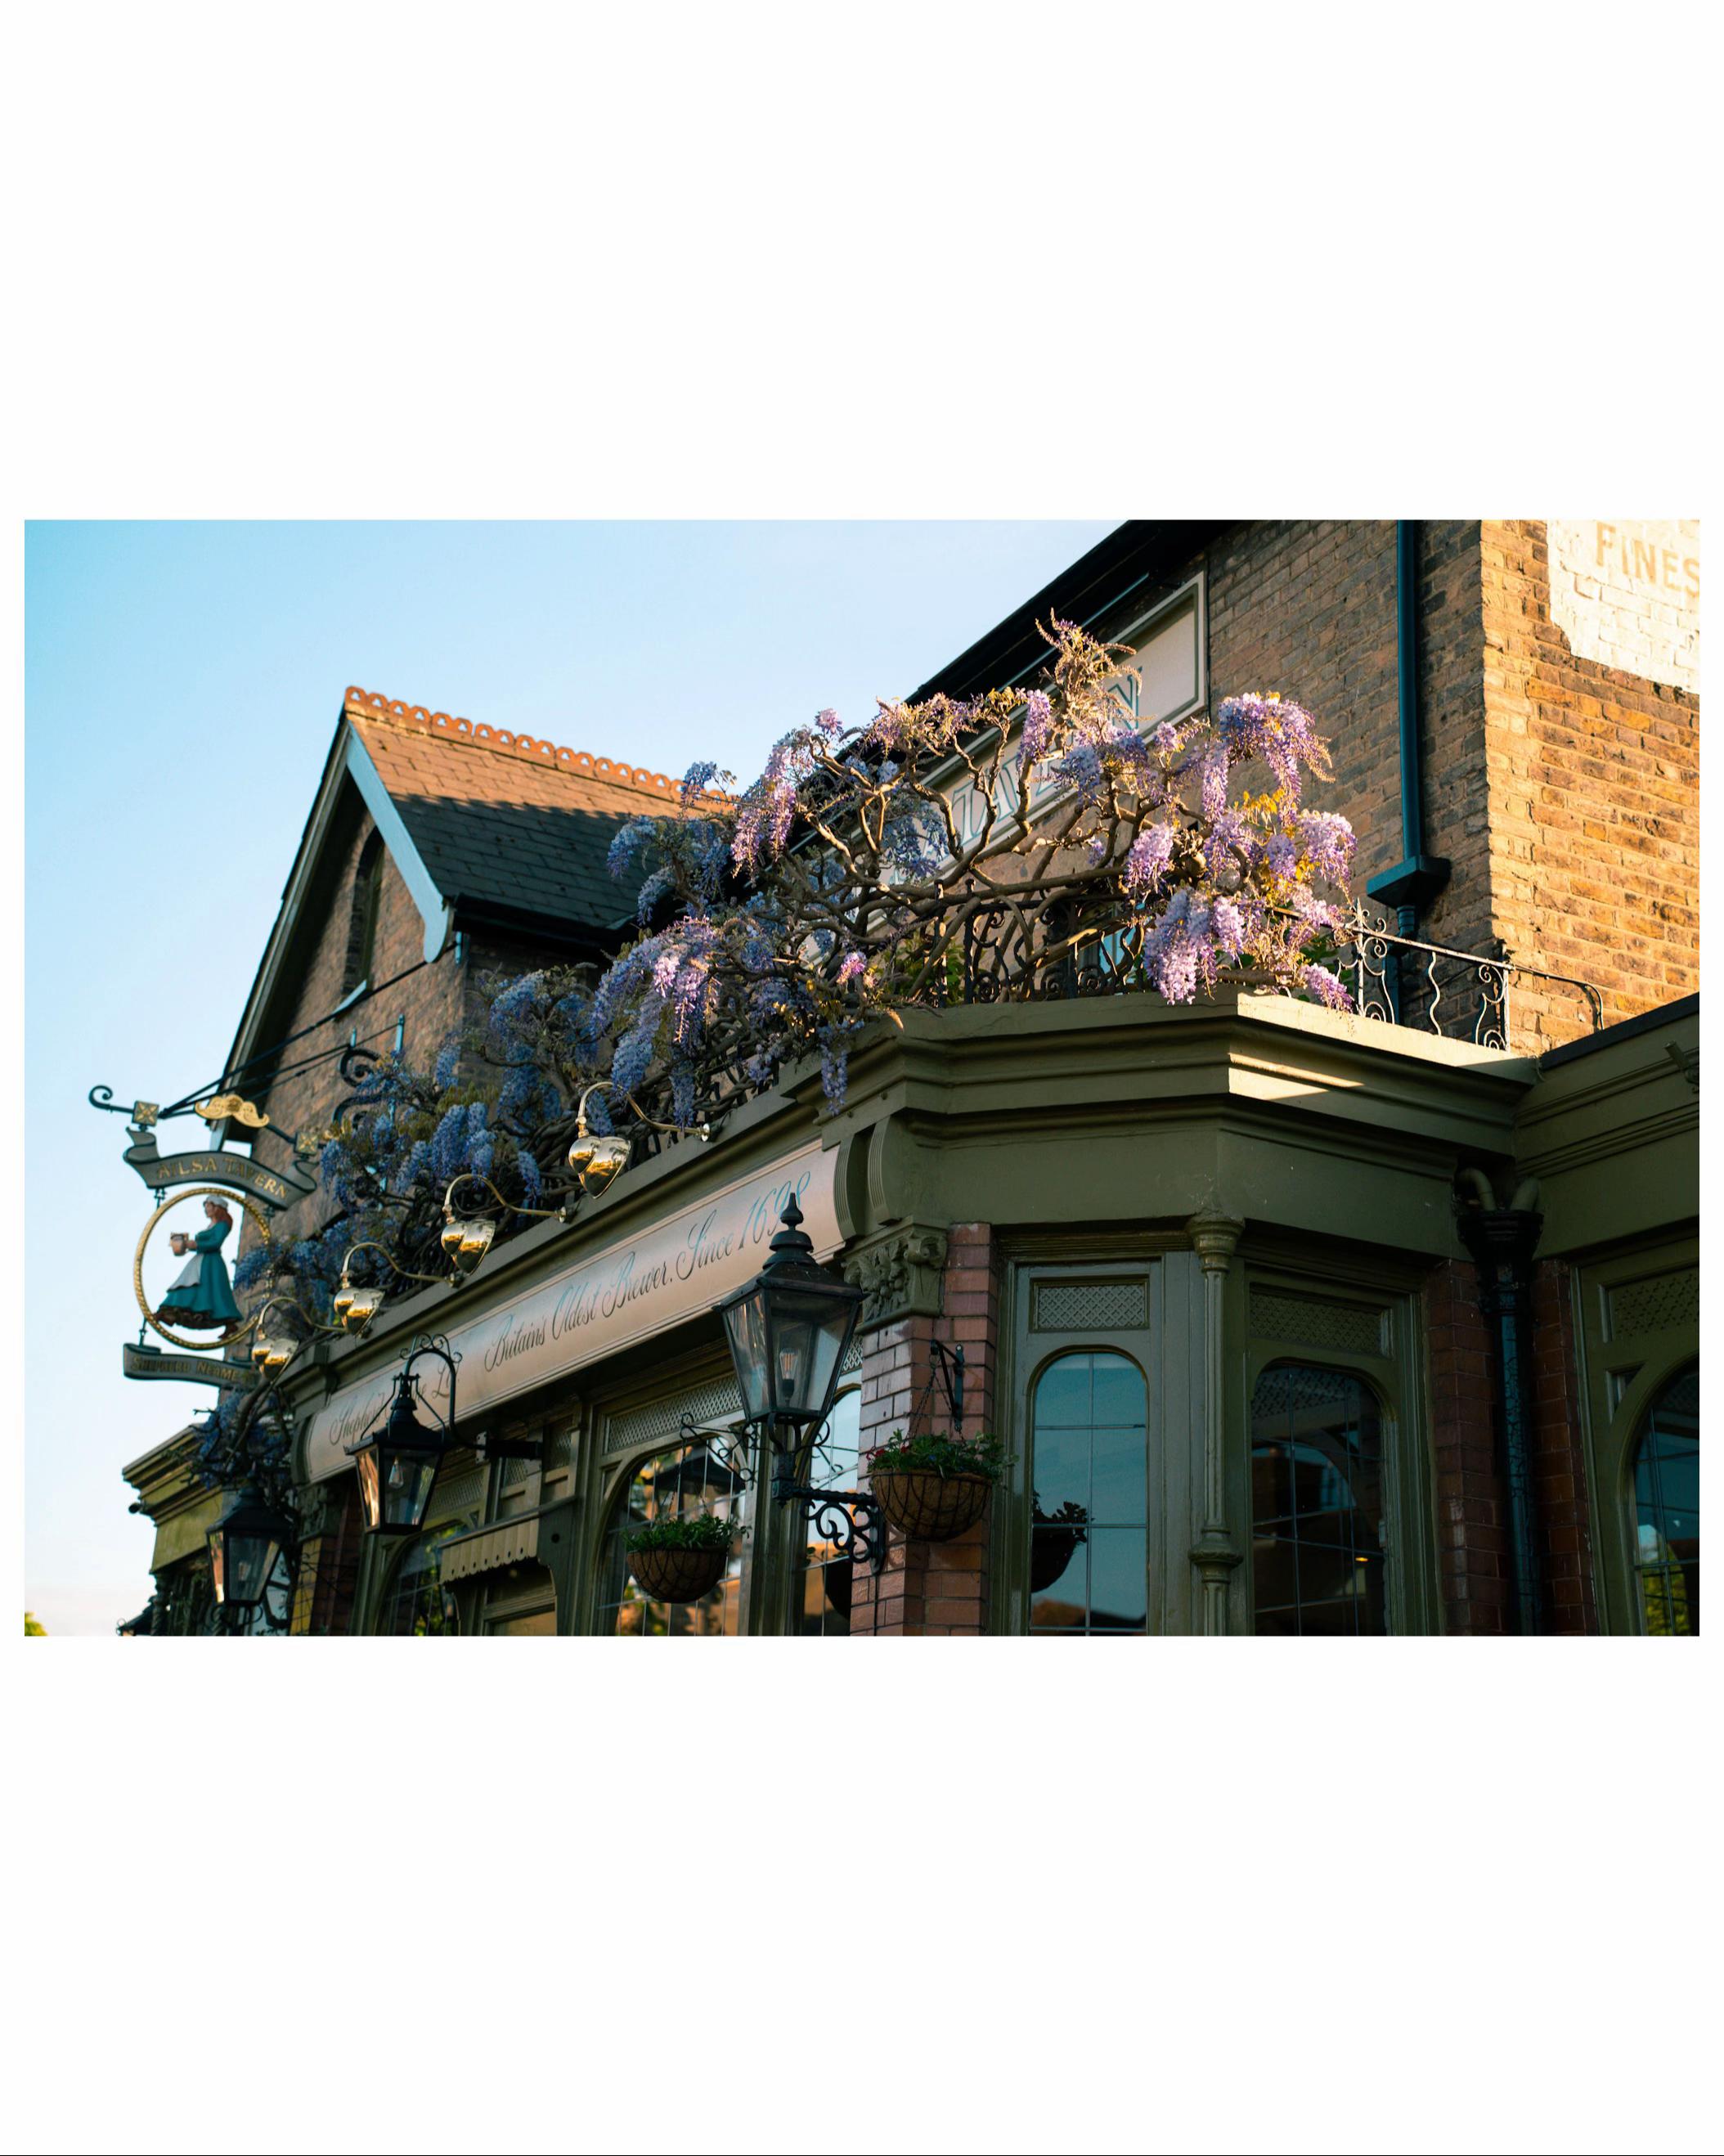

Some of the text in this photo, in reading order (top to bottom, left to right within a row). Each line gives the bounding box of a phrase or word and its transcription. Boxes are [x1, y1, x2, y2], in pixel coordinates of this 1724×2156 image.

[1596, 520, 1699, 598] FINES
[157, 1157, 289, 1199] AILSA TAVERN
[552, 1282, 602, 1341] Oldest
[676, 1209, 734, 1281] Since
